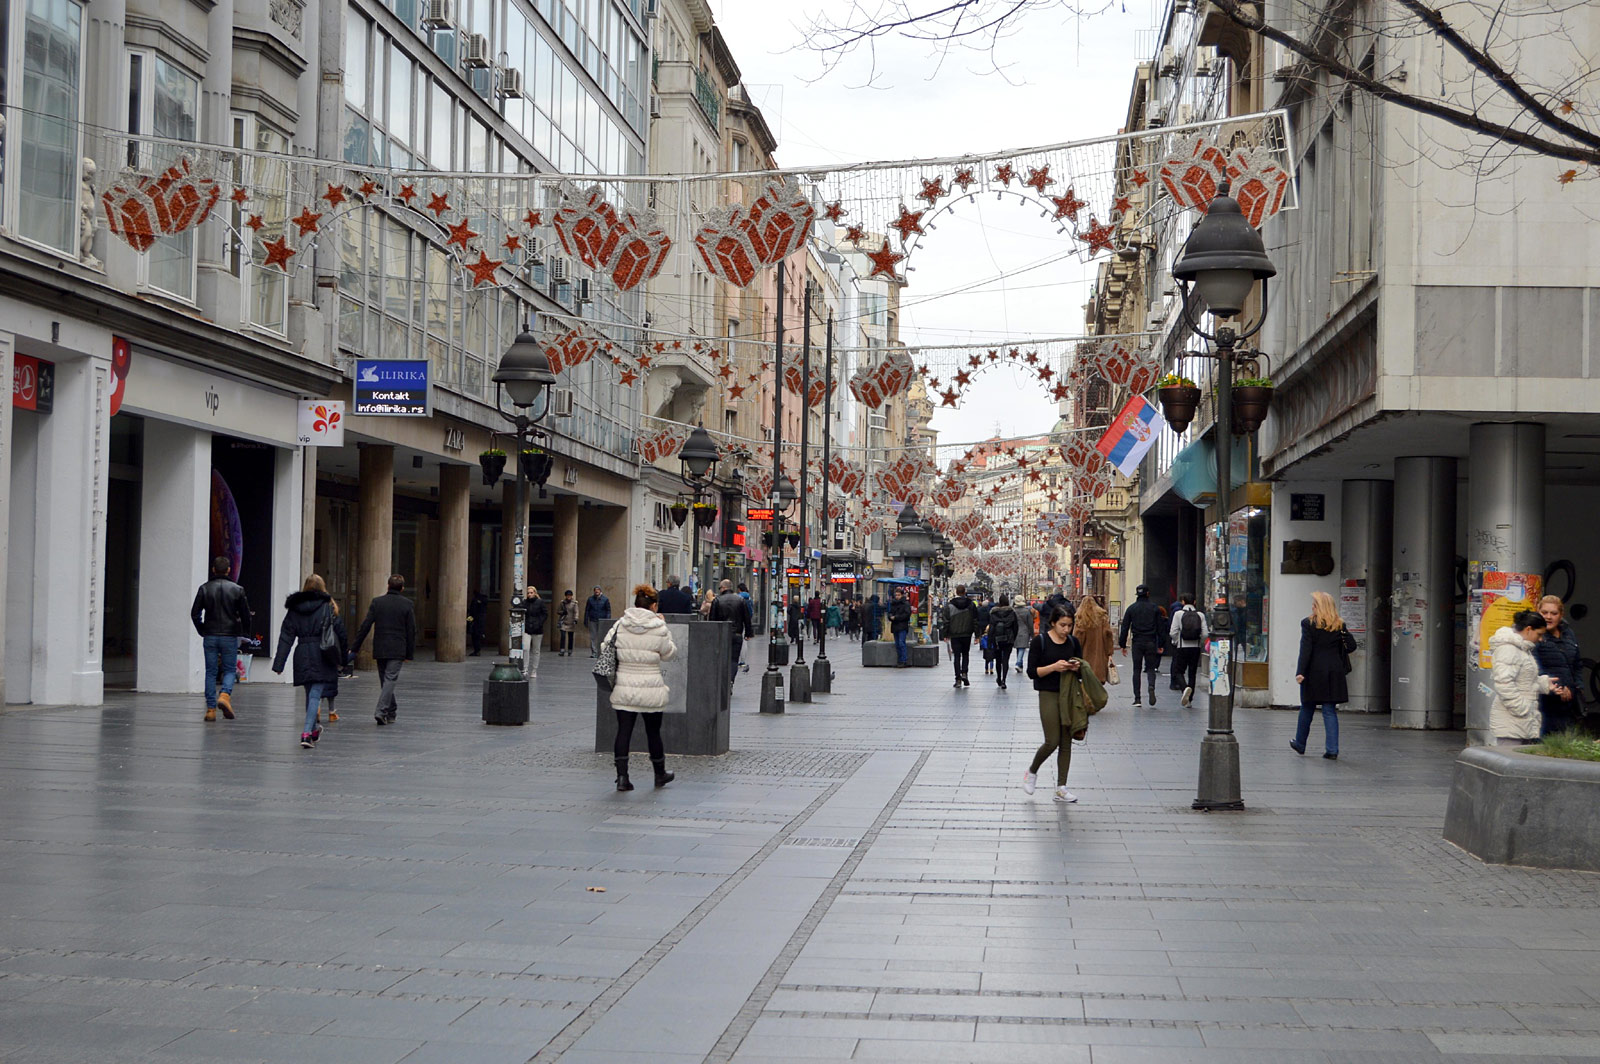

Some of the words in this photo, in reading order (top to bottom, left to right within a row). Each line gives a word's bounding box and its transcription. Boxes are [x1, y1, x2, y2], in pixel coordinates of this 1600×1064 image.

[381, 371, 426, 380] ILIRIKA
[205, 385, 219, 416] vip
[372, 391, 410, 400] Kontakt
[358, 403, 424, 414] info@ilirika.rs
[299, 435, 311, 443] vip
[445, 428, 465, 450] ZARA
